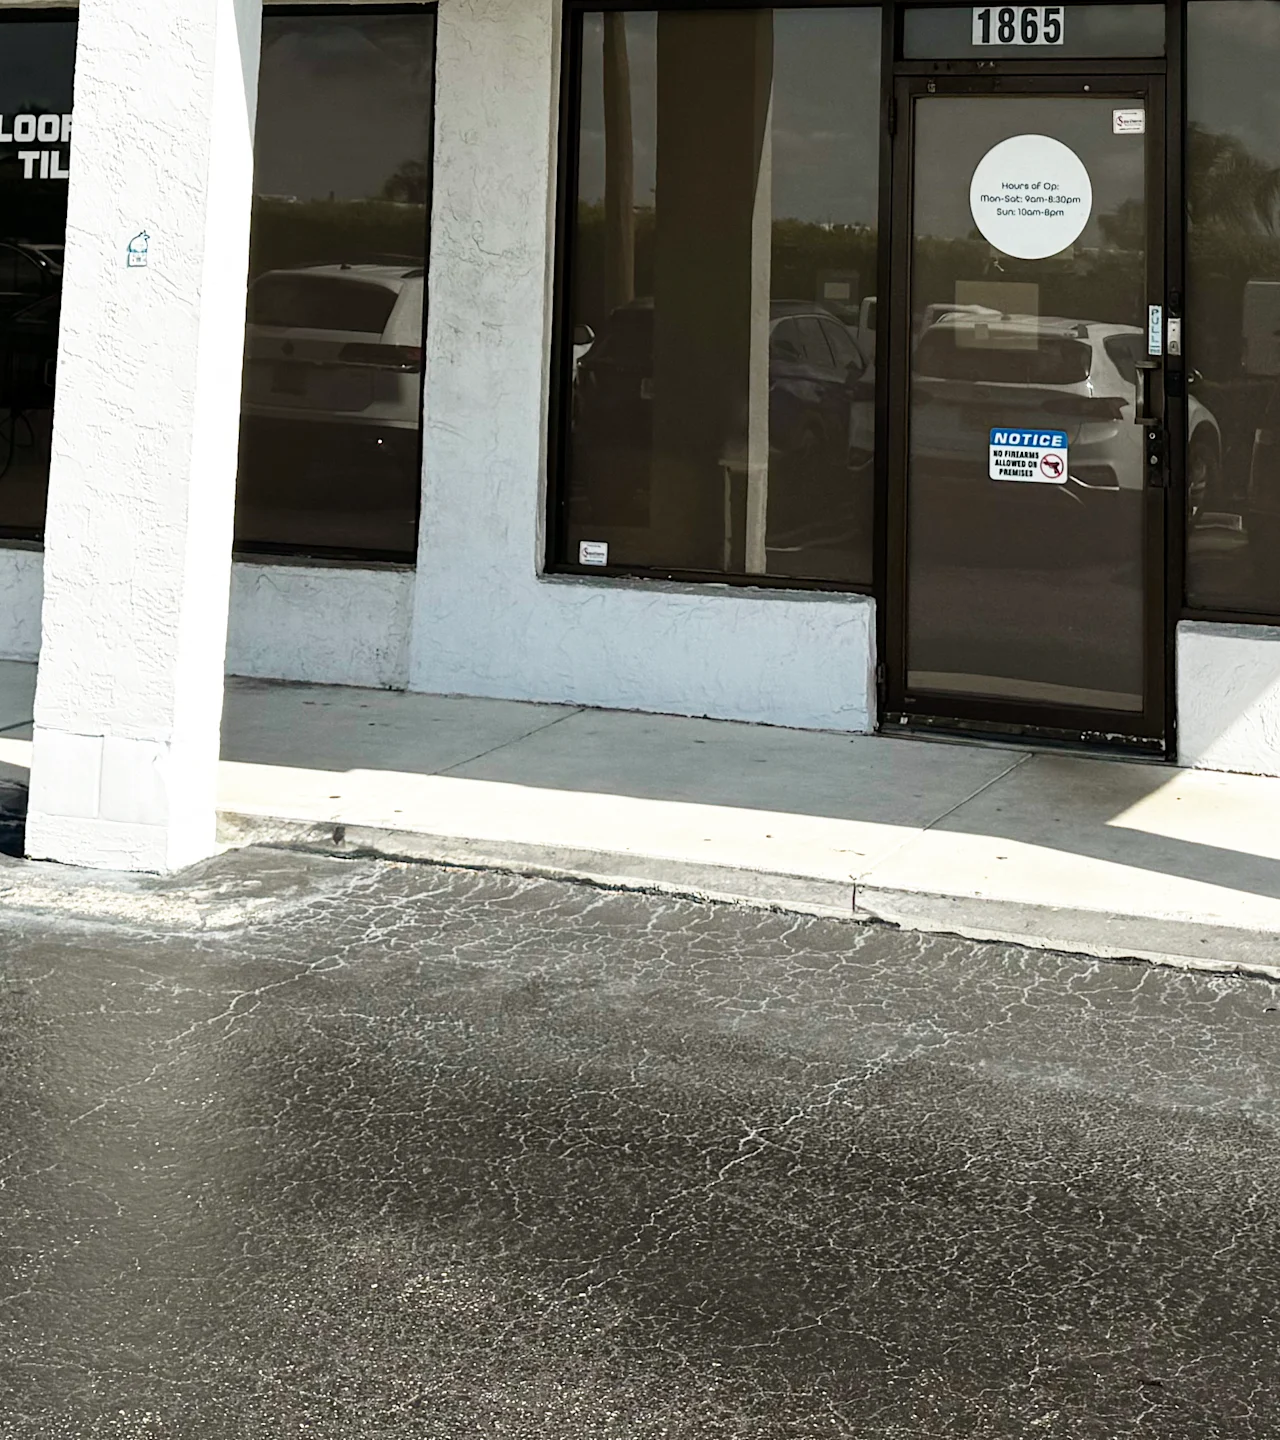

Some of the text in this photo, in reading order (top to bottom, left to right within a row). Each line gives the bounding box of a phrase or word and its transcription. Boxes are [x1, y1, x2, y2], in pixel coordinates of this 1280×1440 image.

[977, 7, 1061, 44] 1865
[1001, 181, 1059, 191] Hours of Op:
[980, 194, 1081, 204] Mon-Sat: 9am-8:30pm
[996, 208, 1064, 217] Sun: 10am-8pm
[1151, 308, 1160, 343] PULL
[994, 432, 1063, 447] NOTICE
[993, 450, 1039, 459] NO FIREARMS
[995, 459, 1026, 468] ALLOWED
[999, 468, 1033, 477] PREMISES
